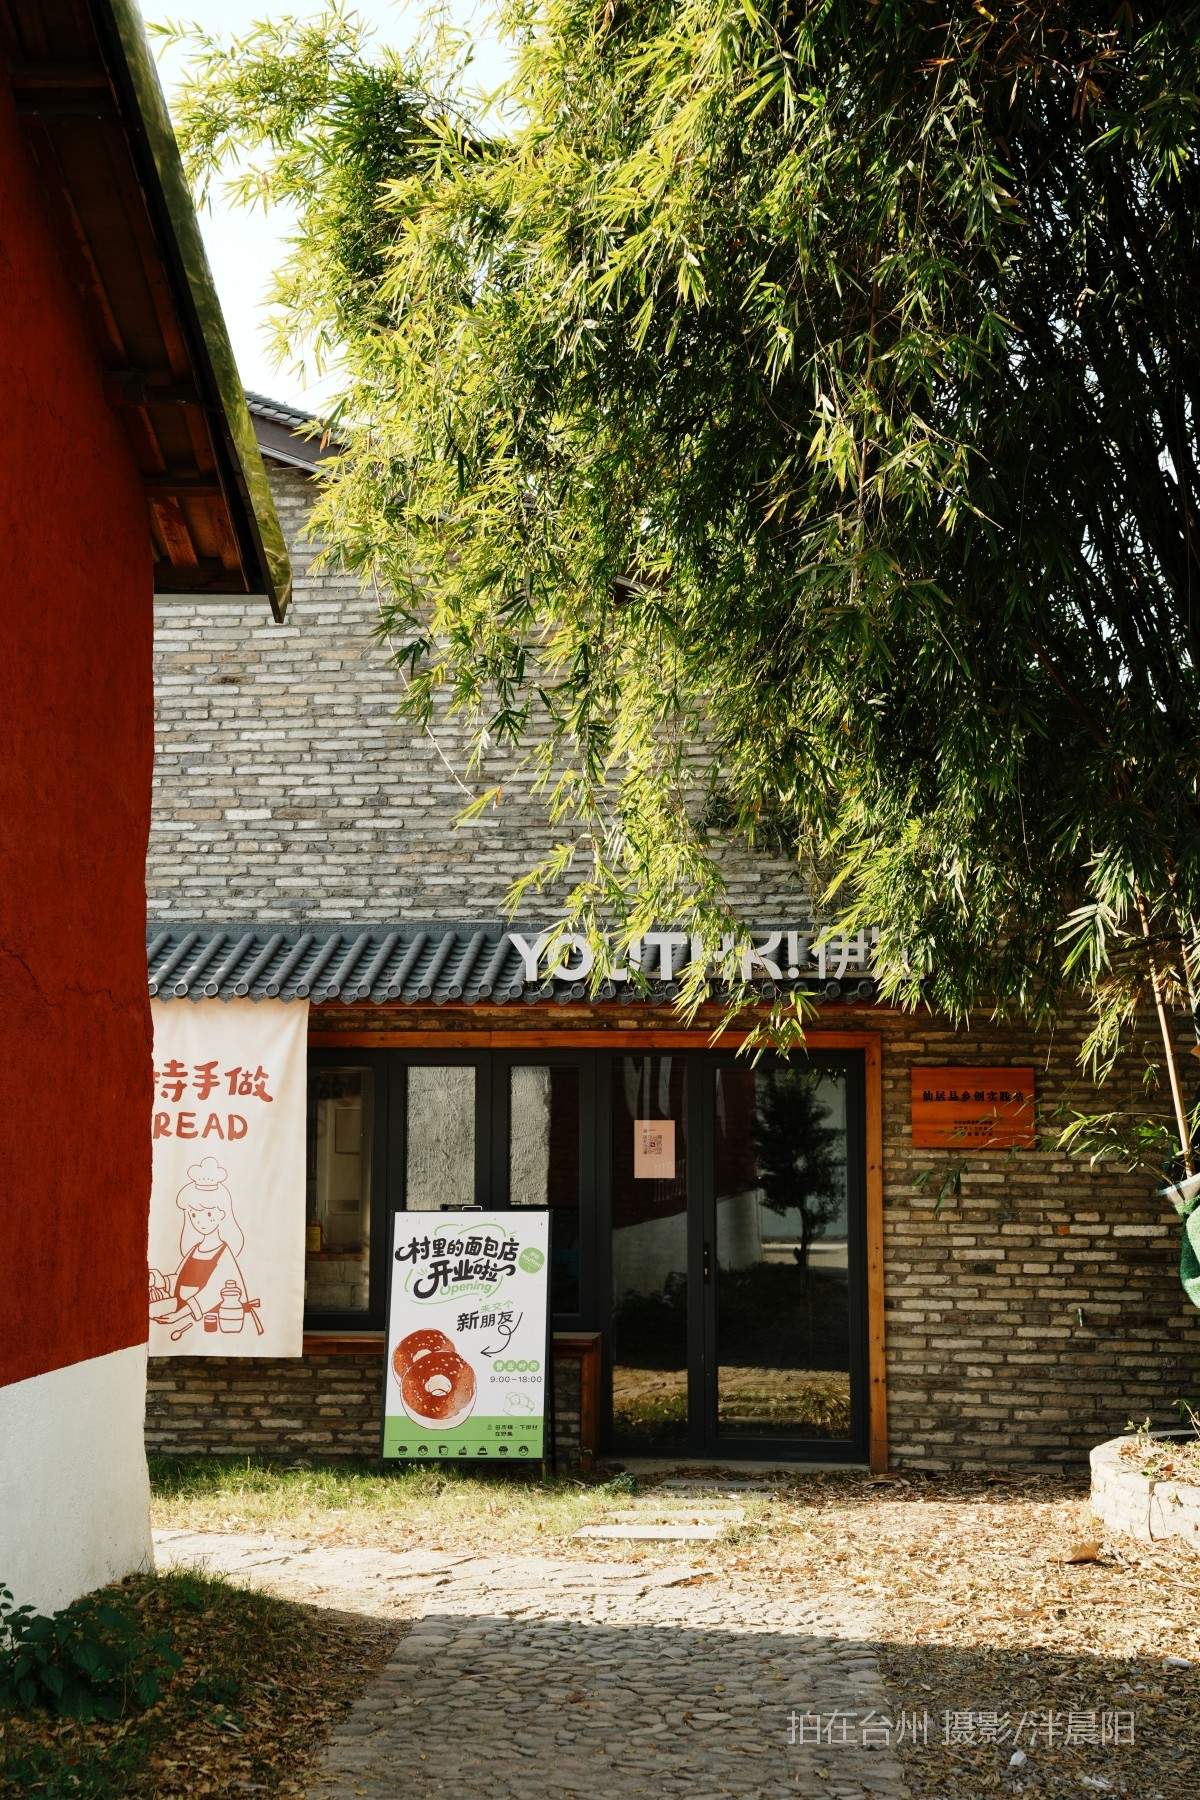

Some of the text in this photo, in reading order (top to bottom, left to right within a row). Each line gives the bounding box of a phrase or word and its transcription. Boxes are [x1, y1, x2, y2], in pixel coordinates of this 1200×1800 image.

[394, 1235, 521, 1265] 村里的面包店
[413, 1257, 517, 1299] 开业啦
[440, 1280, 493, 1296] Opening
[456, 1310, 515, 1332] 新朋友
